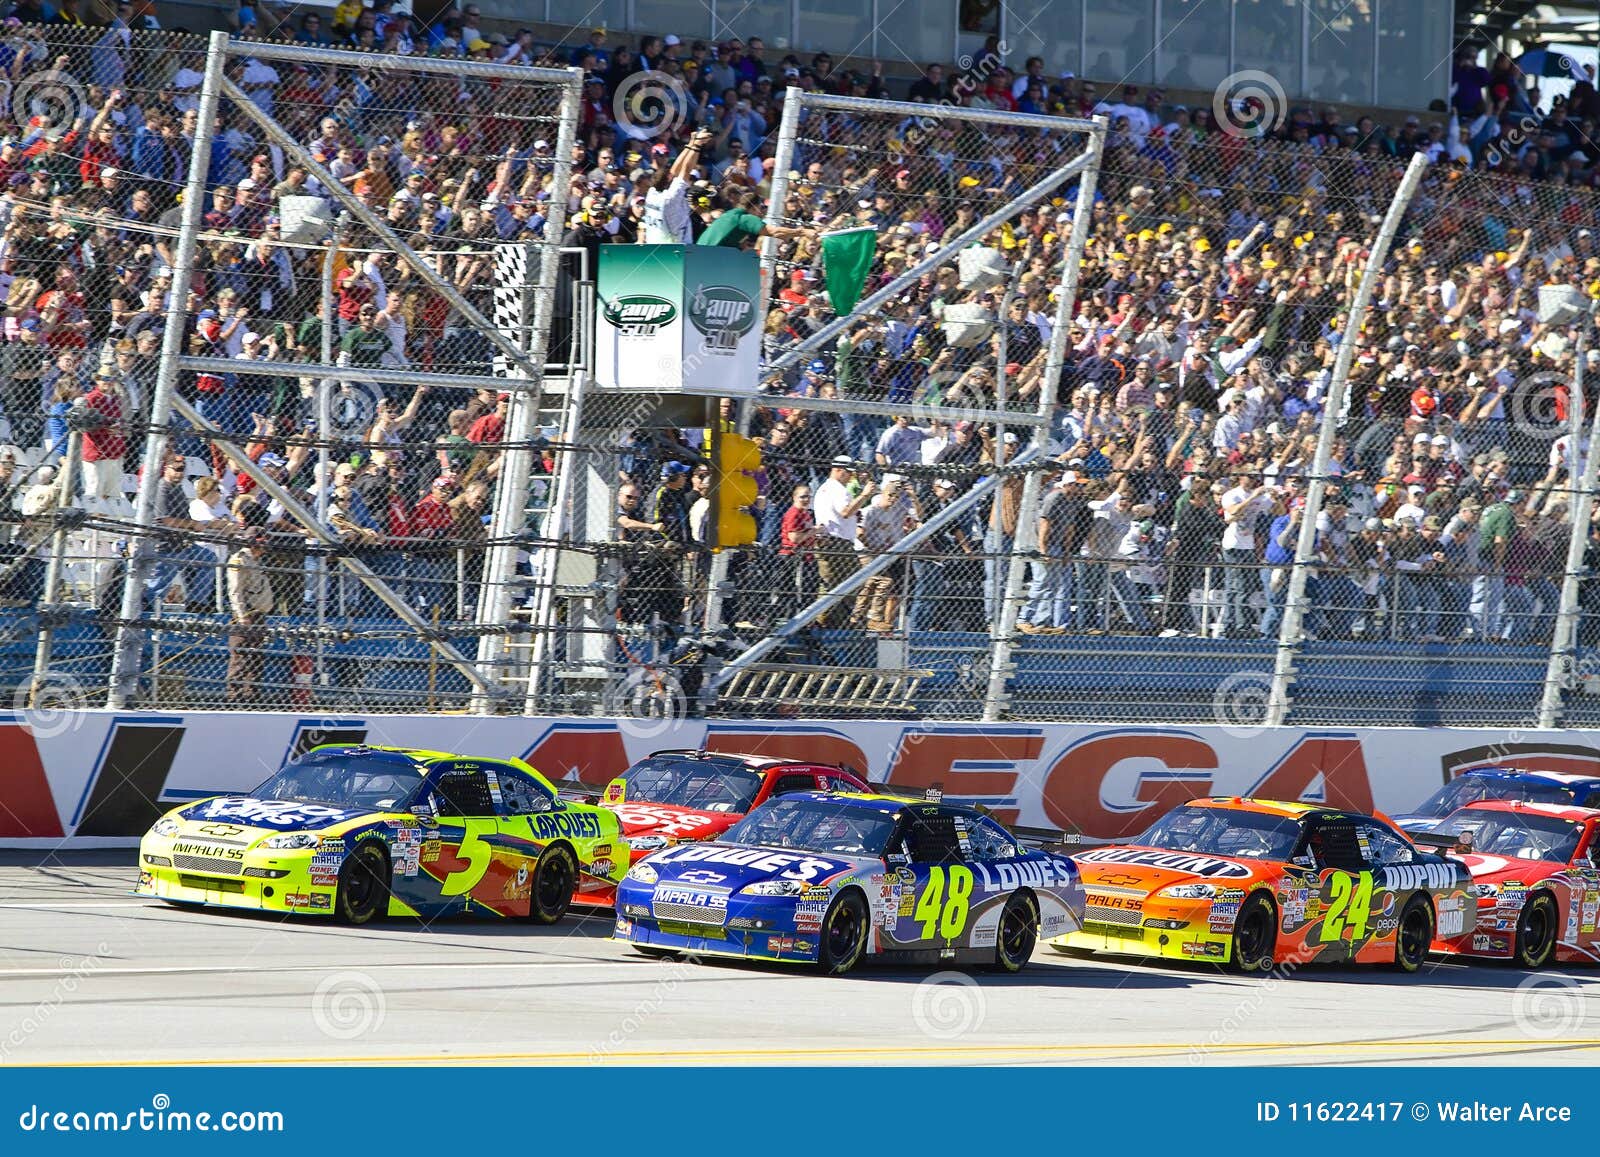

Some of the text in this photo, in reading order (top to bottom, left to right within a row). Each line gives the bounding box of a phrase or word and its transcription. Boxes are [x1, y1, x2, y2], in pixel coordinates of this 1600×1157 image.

[526, 813, 601, 839] CARQUEST
[173, 843, 245, 860] IMPALA SS
[311, 856, 342, 865] MAHLE
[441, 818, 499, 897] 5
[650, 846, 834, 882] LOWE'S
[974, 857, 1070, 892] LOWE'S
[1382, 863, 1457, 891] DUPONT
[653, 887, 729, 908] IMPALA SS
[797, 904, 826, 912] MAHLE
[913, 865, 974, 940] 48
[1086, 894, 1144, 911] PALA SS
[1320, 870, 1373, 942] 24
